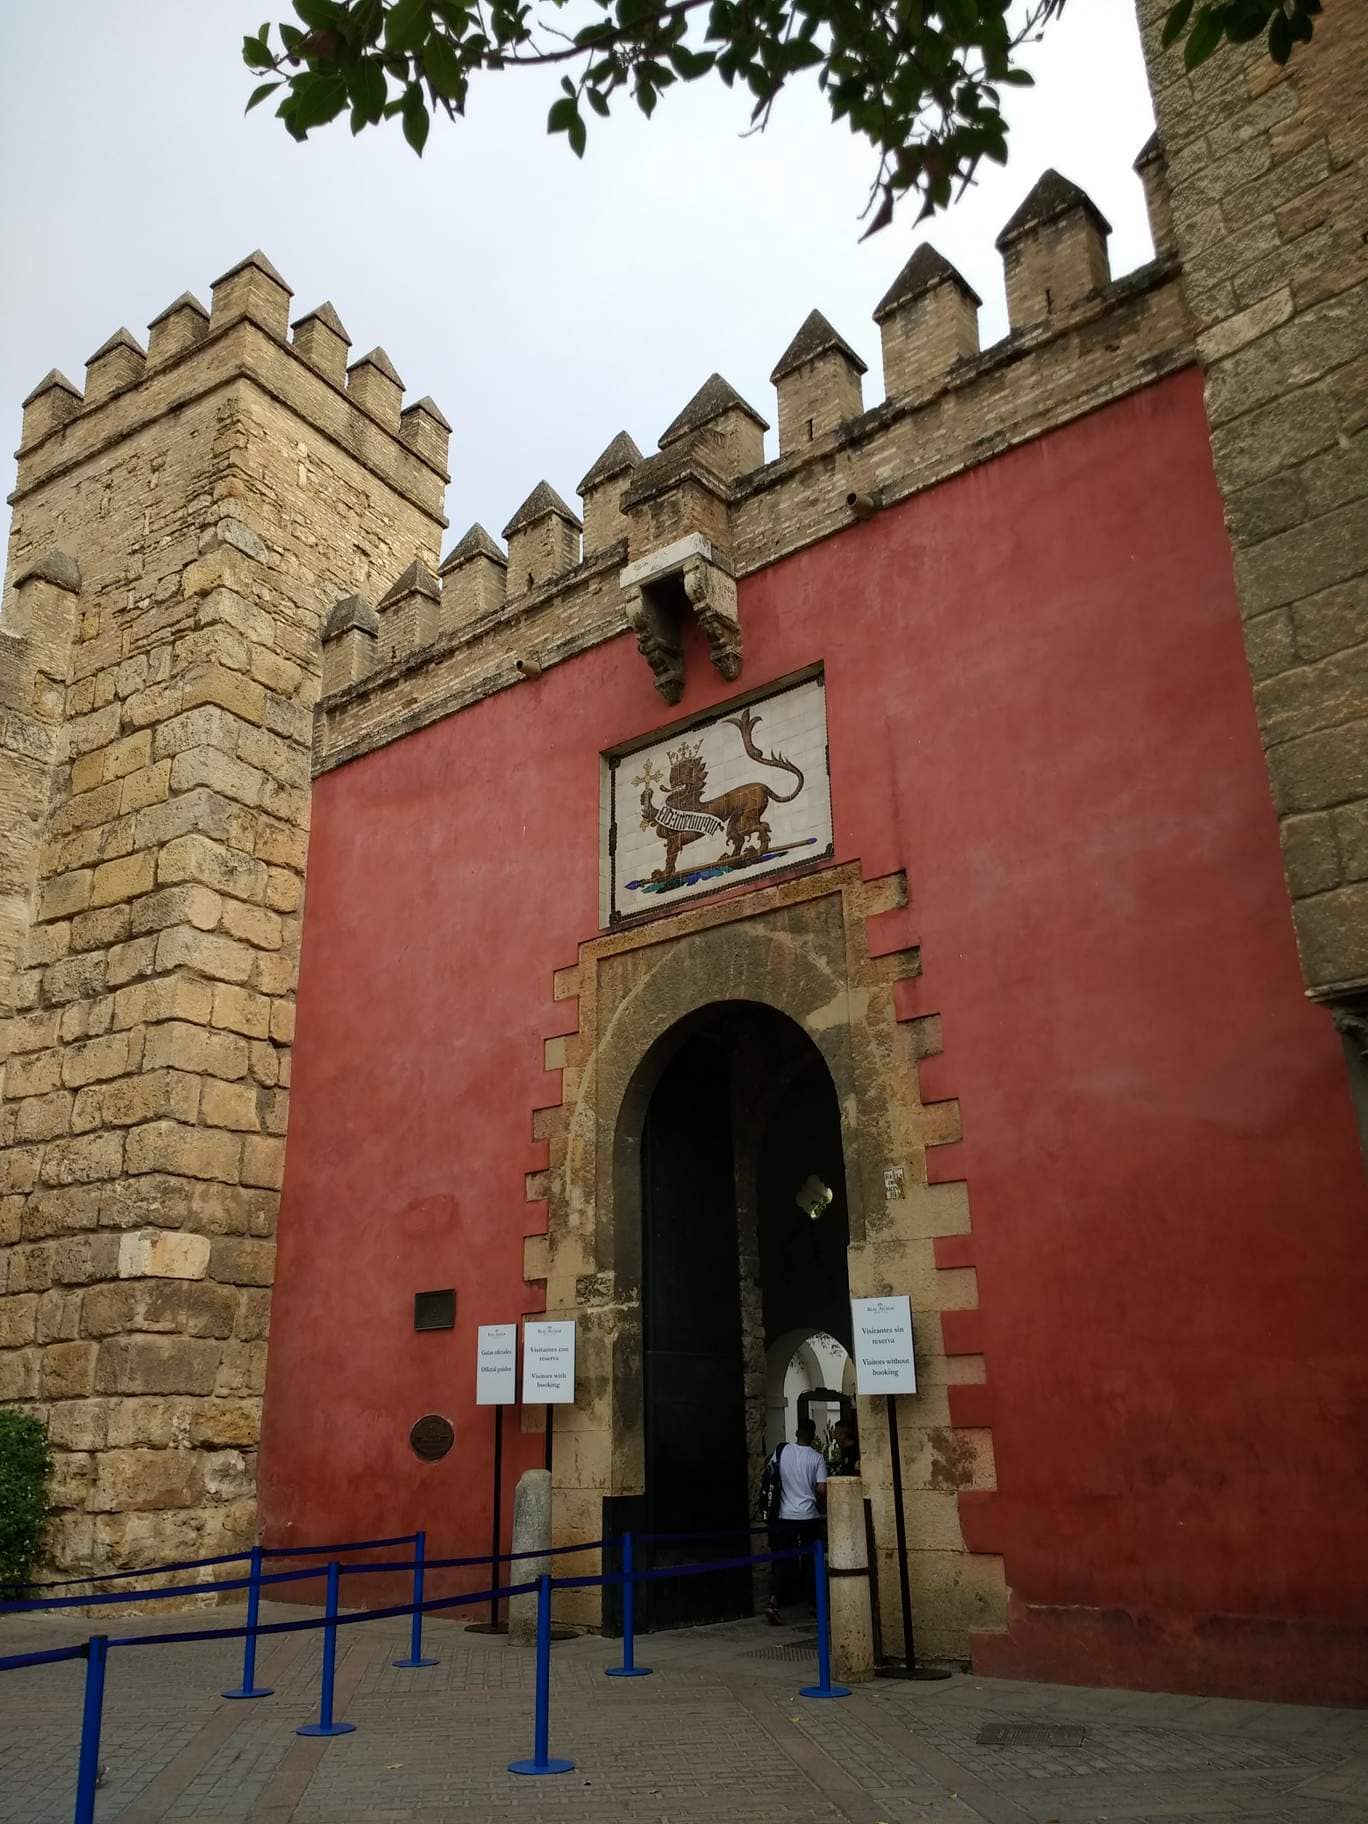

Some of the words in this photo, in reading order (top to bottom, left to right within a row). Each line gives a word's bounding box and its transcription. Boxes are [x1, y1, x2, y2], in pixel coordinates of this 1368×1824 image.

[862, 1327, 893, 1335] Visitantes
[862, 1358, 885, 1366] Visitors
[886, 1357, 910, 1365] without
[872, 1368, 899, 1377] booking
